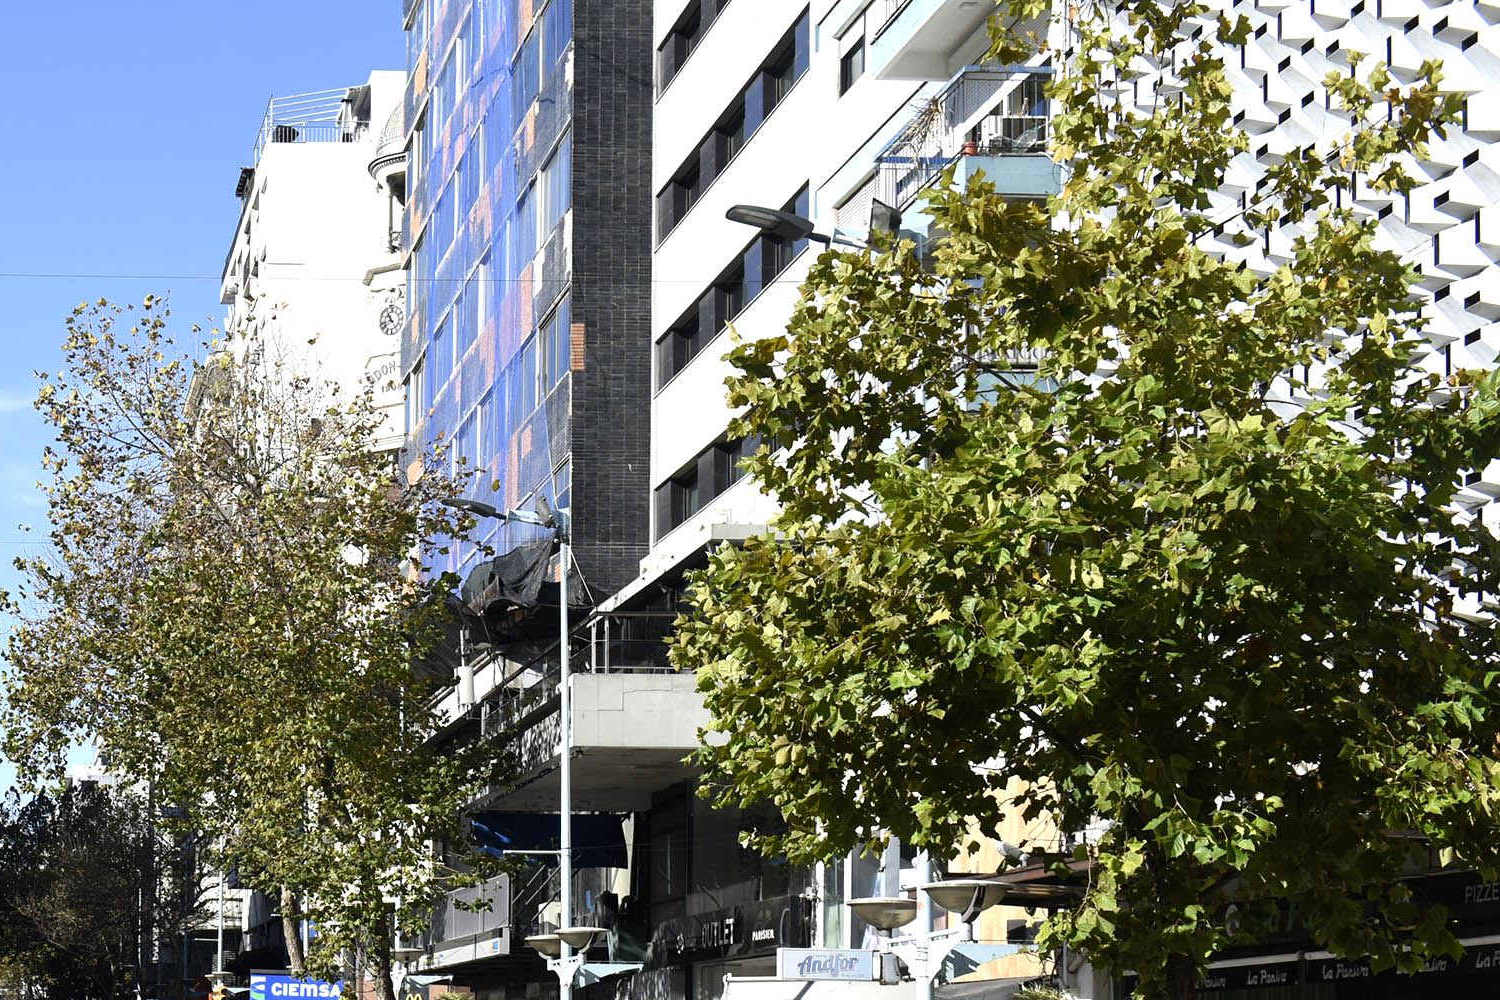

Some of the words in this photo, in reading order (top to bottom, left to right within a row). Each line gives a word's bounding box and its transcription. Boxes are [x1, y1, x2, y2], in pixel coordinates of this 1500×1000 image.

[702, 918, 735, 948] OUTLET
[1476, 952, 1491, 968] La
[1247, 970, 1258, 985] La
[1260, 969, 1288, 984] Pasiva
[1323, 965, 1333, 979] La
[271, 982, 341, 998] CIEMSA
